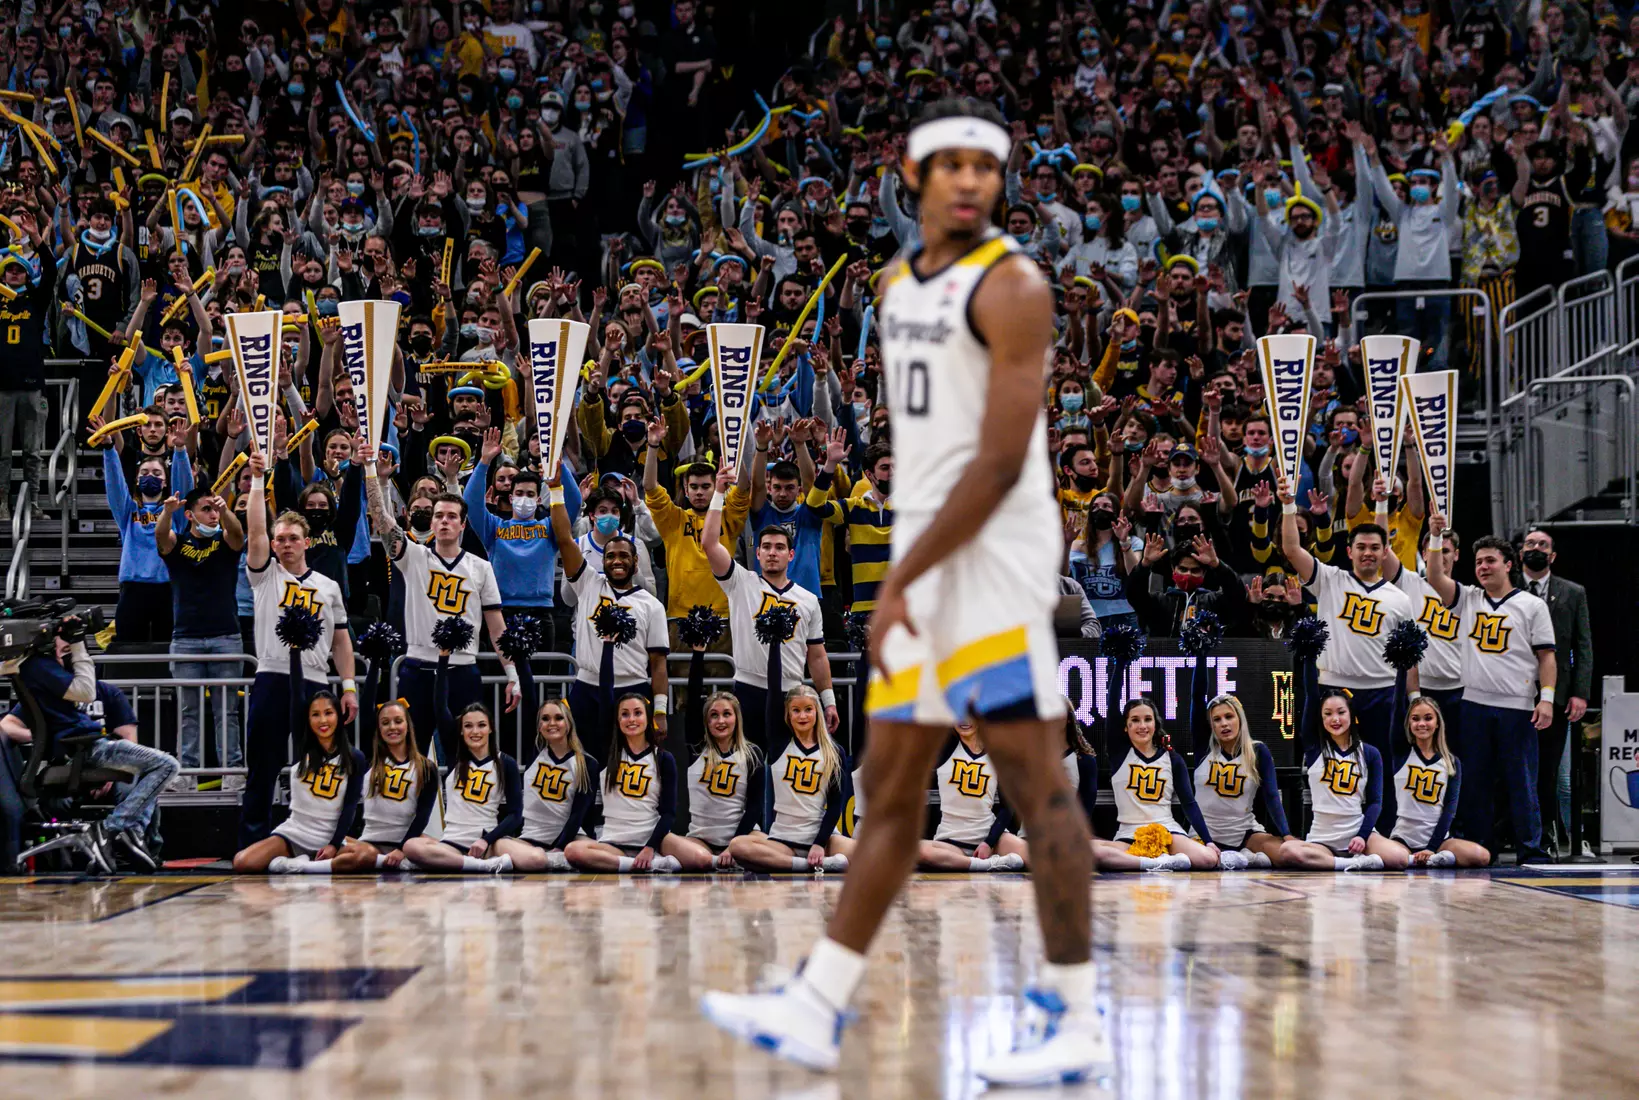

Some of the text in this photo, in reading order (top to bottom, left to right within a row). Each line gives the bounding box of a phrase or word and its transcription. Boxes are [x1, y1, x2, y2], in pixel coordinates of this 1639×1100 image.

[1533, 206, 1549, 228] 3
[87, 277, 102, 300] 3
[7, 324, 21, 345] 0
[342, 322, 365, 391] RING
[206, 399, 219, 419] 0
[240, 333, 271, 457] RING OUT
[531, 340, 557, 464] RING OUT
[719, 345, 752, 467] RING OUT
[1274, 358, 1305, 481] RING OUT
[1368, 357, 1399, 478] RING OUT
[1415, 393, 1448, 515] RING OUT
[495, 524, 549, 541] MARQUETTE
[427, 570, 472, 615] MU
[1338, 592, 1386, 638] MU
[1416, 596, 1460, 641] MU
[1468, 612, 1513, 655] MU
[1624, 729, 1639, 743] M
[532, 762, 571, 802] MU
[615, 760, 648, 798] MU
[699, 756, 740, 798] MU
[783, 754, 823, 796] MU
[948, 758, 992, 799] MU
[1126, 763, 1168, 804] MU
[1205, 760, 1248, 799] MU
[1319, 756, 1361, 796] MU
[1403, 764, 1444, 805] MU
